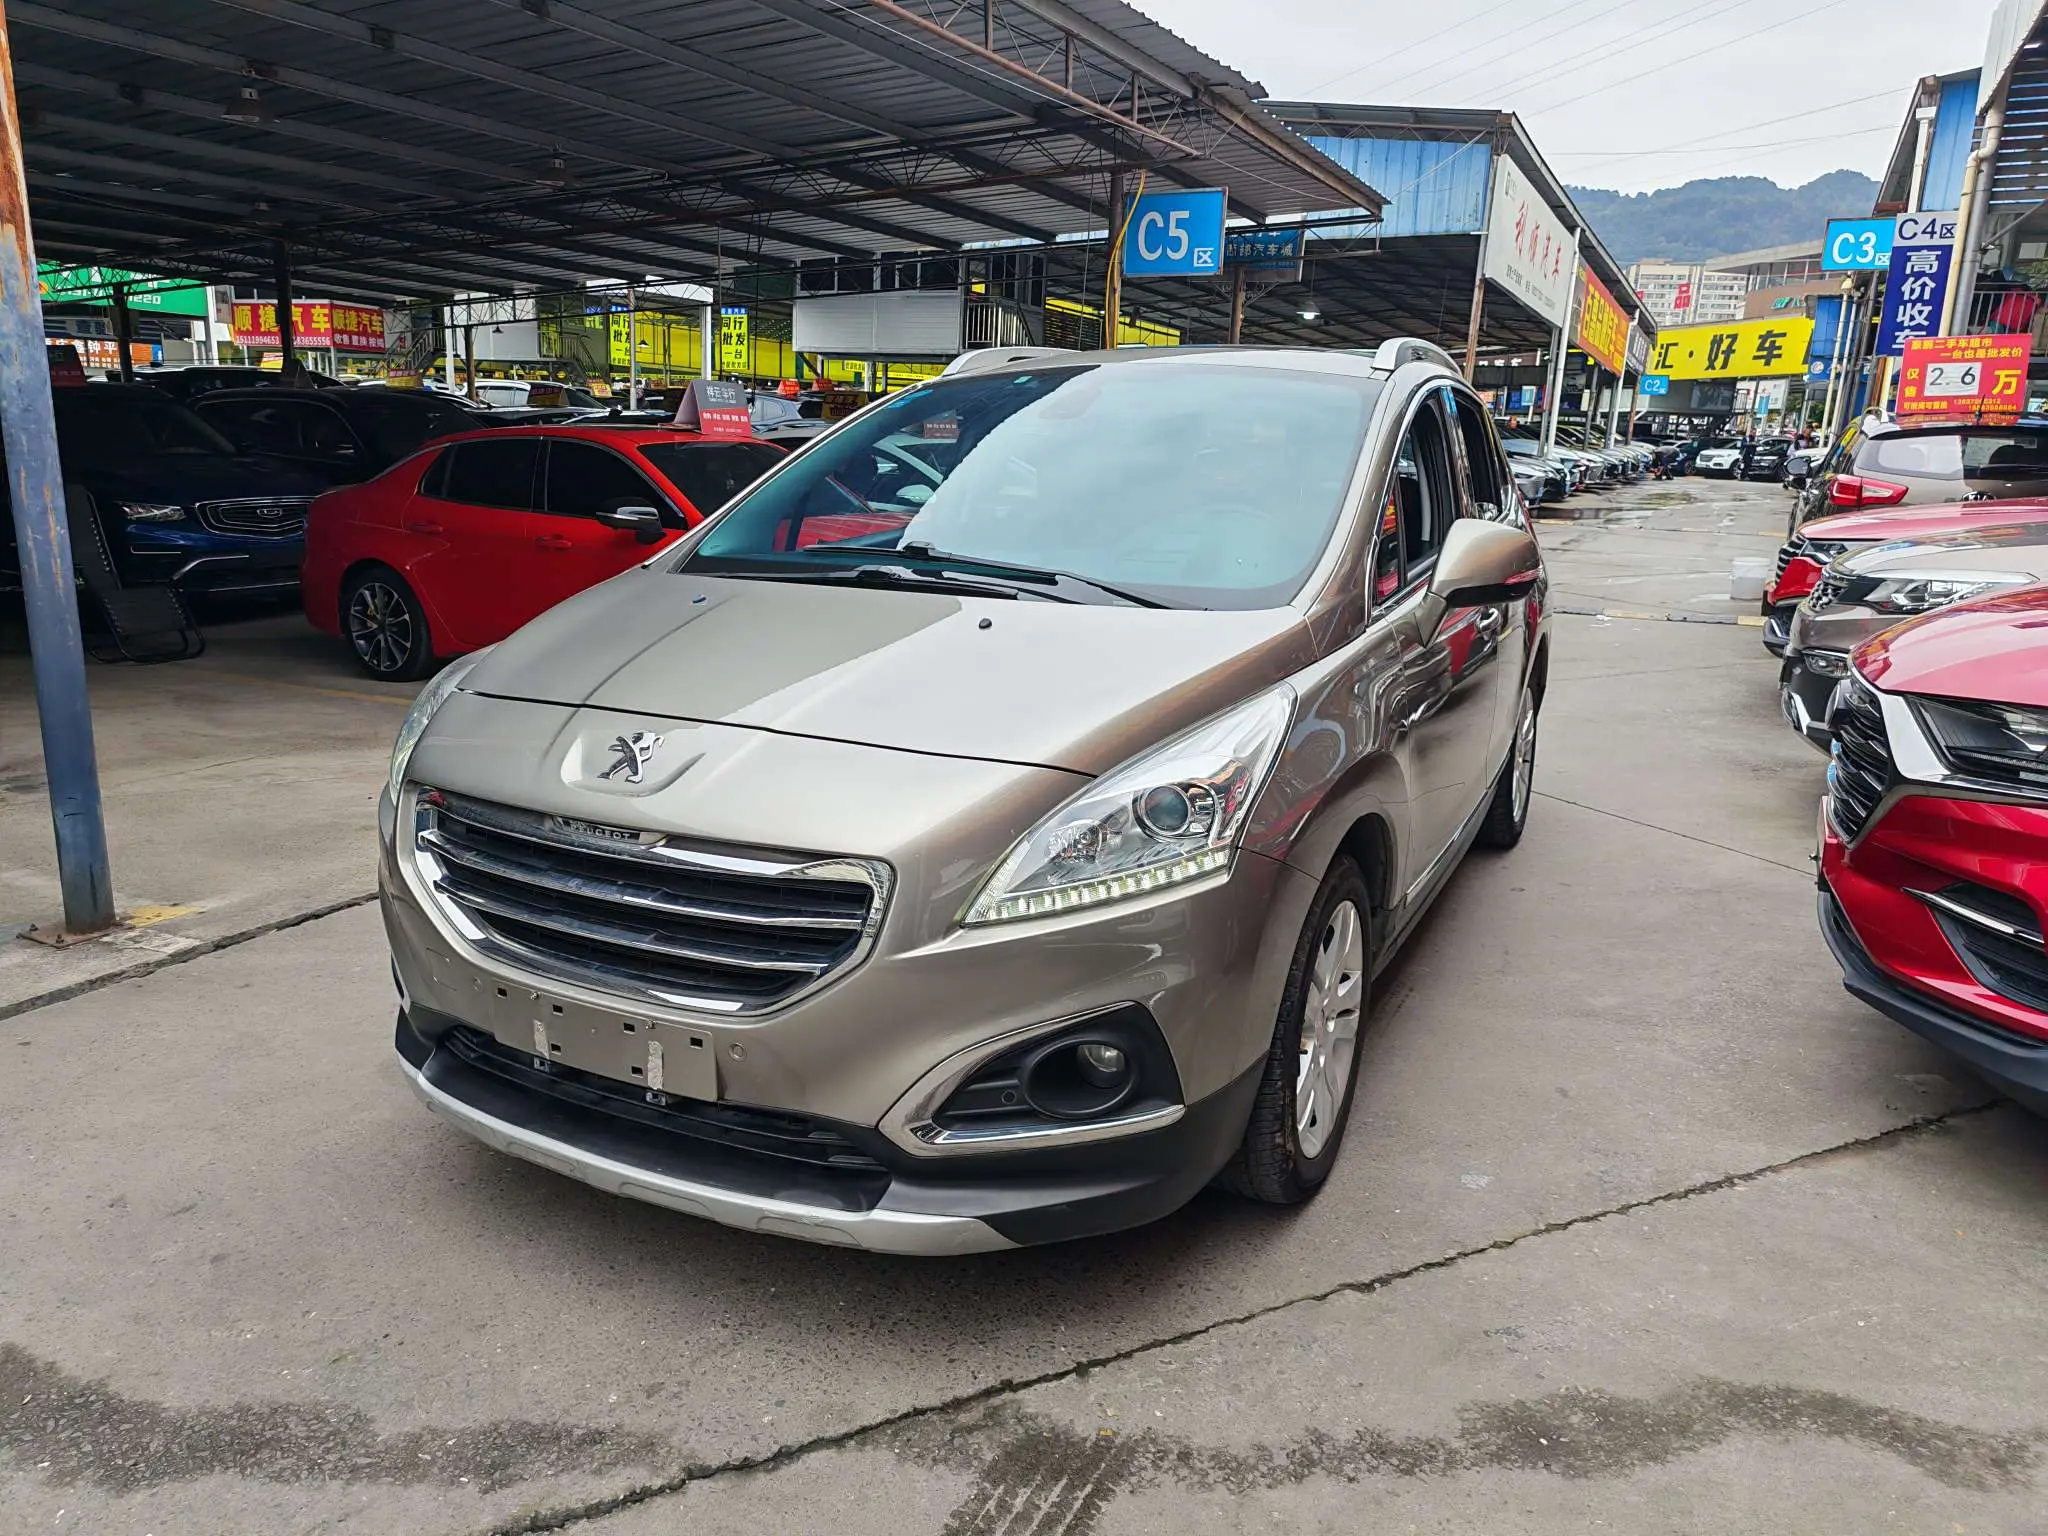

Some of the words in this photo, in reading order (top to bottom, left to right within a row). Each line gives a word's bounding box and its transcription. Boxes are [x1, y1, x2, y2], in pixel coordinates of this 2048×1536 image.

[722, 316, 744, 330] 同行
[722, 333, 745, 346] 批发
[724, 349, 743, 359] 一台
[1940, 347, 2023, 359] 一台也是批发价
[1929, 366, 1976, 386] 2.6
[1991, 369, 2022, 396] 万
[570, 823, 631, 840] PEUGEOT
